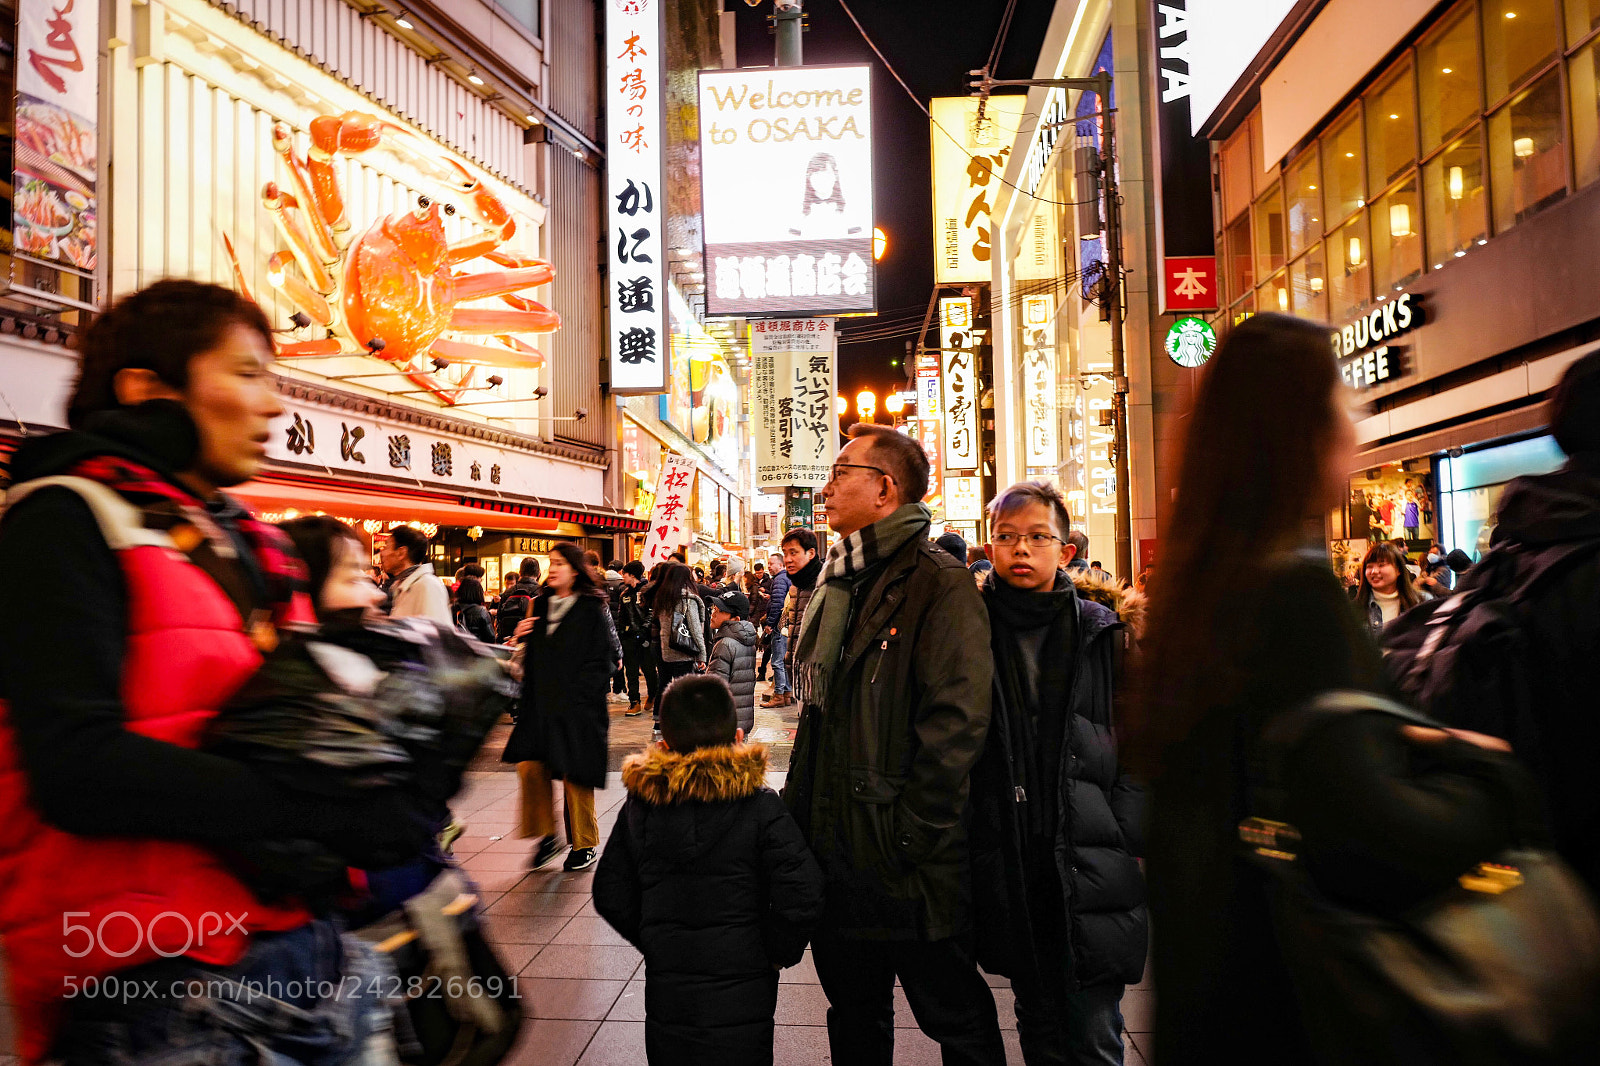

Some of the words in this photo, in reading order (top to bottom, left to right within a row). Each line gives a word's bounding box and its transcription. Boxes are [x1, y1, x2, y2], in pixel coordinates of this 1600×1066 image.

[1158, 3, 1191, 103] AYA
[617, 30, 648, 154] 本場の味
[707, 80, 863, 112] Welcome
[709, 121, 738, 145] to
[747, 115, 866, 143] OSAKA
[1173, 267, 1208, 301] 本
[754, 319, 830, 333] 道頓堀商店会
[1330, 292, 1412, 359] RBUCKS
[1341, 345, 1390, 390] FFEE
[778, 396, 794, 459] 客引き
[761, 473, 826, 482] 06-6765-1872
[1089, 397, 1117, 515] FOREVER
[650, 466, 689, 561] 松葉かに
